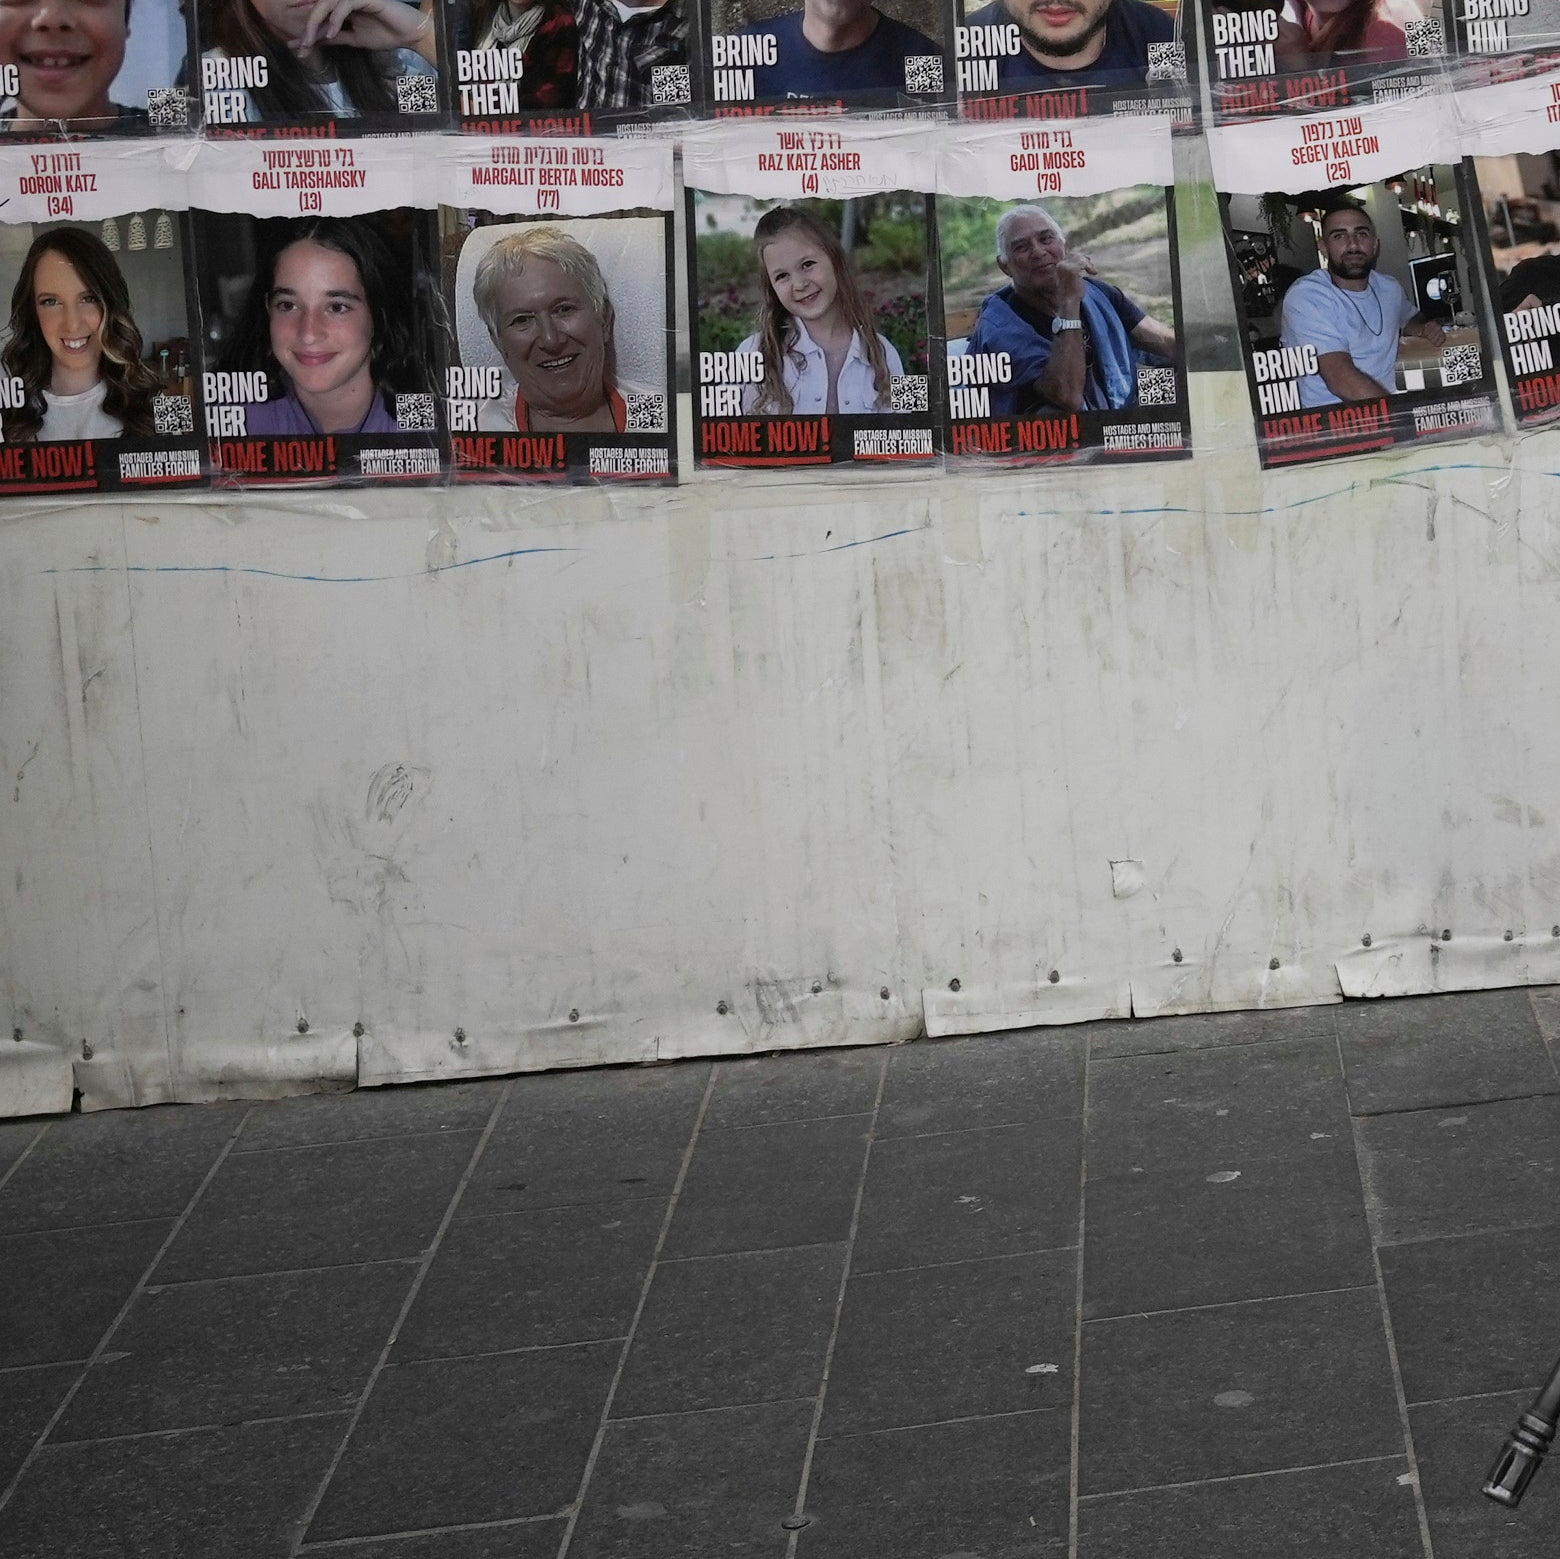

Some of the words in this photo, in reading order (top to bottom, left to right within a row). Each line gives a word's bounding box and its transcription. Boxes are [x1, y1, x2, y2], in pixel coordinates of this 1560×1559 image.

[759, 153, 784, 171] RAZ
[786, 150, 817, 171] KATZ
[820, 152, 861, 171] ASHER
[1010, 153, 1040, 172] GADI
[1042, 150, 1086, 171] MOSES
[1291, 144, 1329, 166] SEGEV
[1331, 136, 1380, 159] KALFON
[19, 173, 63, 196] DORON
[65, 174, 96, 193] KATZ
[252, 170, 281, 190] GALI
[284, 169, 366, 190] TARSHANSKY
[472, 167, 535, 185] MARGALIT
[539, 167, 578, 186] BERTA
[581, 168, 624, 187] MOSES
[946, 351, 1012, 386] BRING
[949, 387, 991, 420] HIM
[951, 421, 1012, 455] HOME
[1018, 414, 1080, 452] NOW!
[1103, 424, 1137, 436] HOSTAGES
[1138, 423, 1150, 435] AND
[1151, 421, 1182, 434] MISSING
[1103, 436, 1146, 451] FAMILIES
[1147, 433, 1183, 449] FORUM
